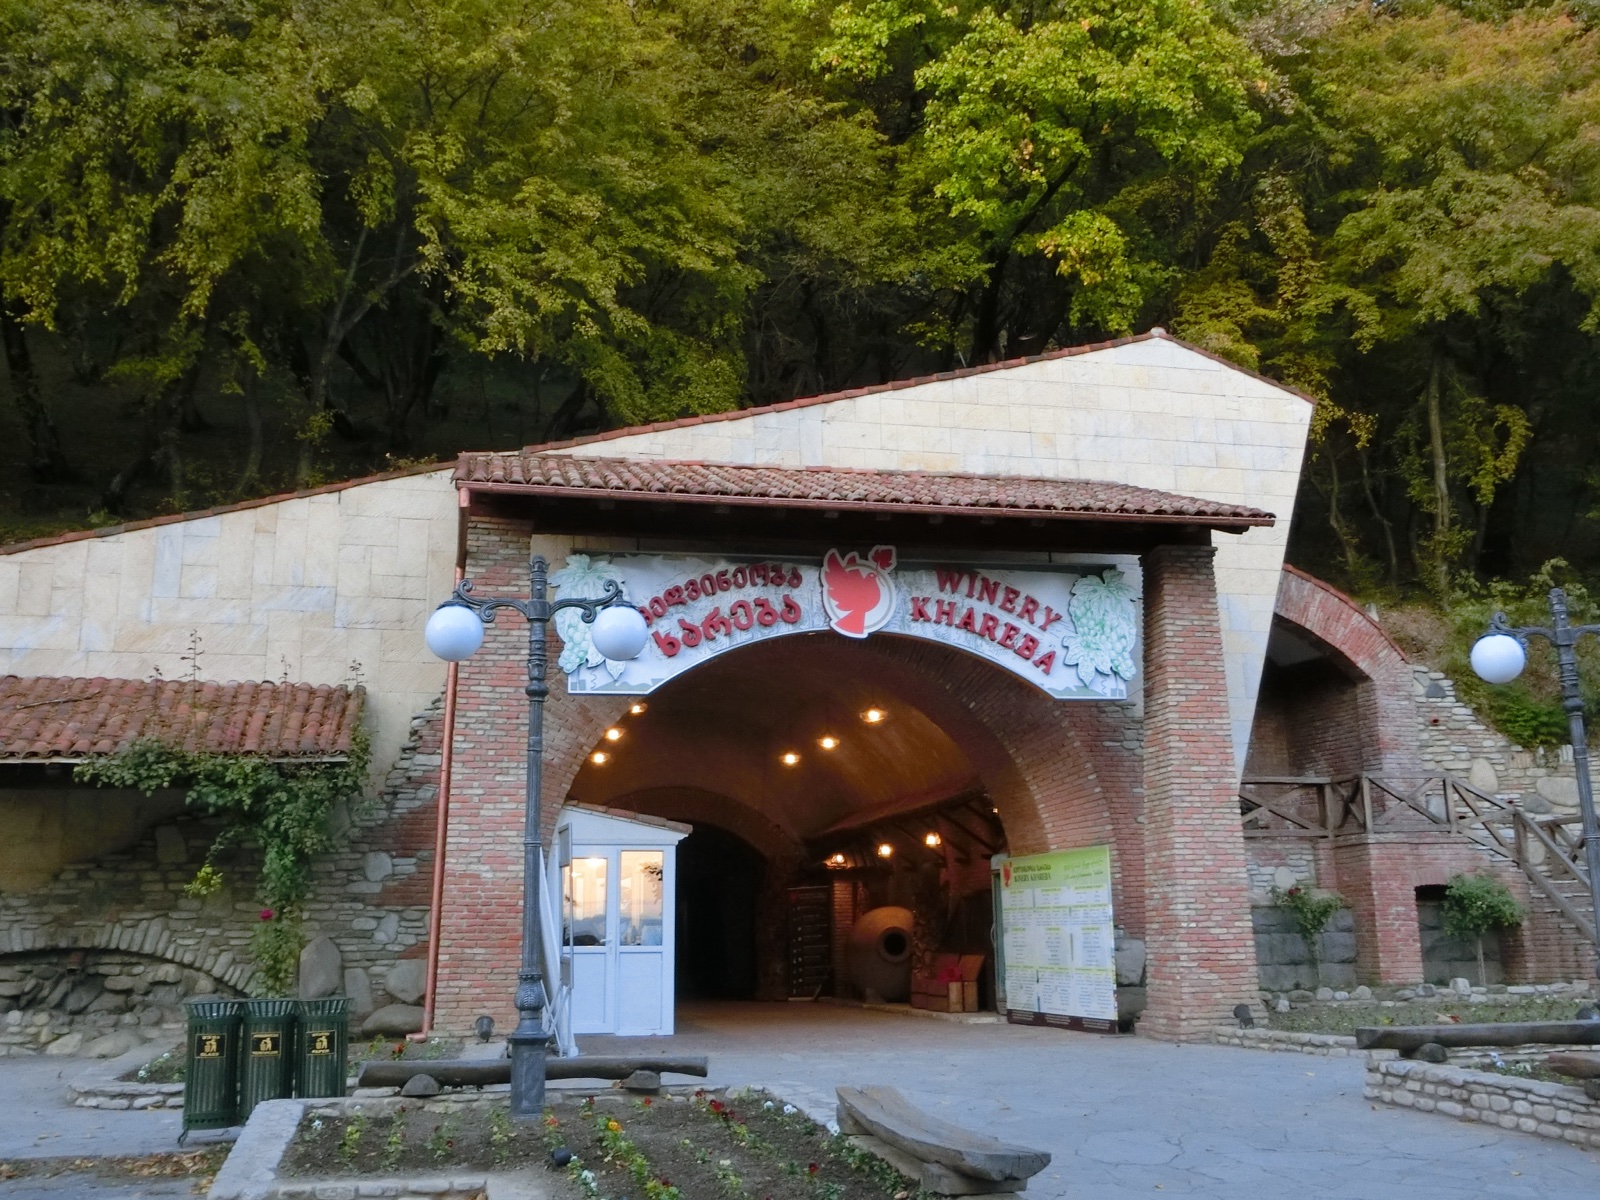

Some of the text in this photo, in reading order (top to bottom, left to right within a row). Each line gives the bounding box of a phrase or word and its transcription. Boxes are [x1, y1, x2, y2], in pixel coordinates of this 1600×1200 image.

[651, 594, 803, 657] ხარება
[936, 567, 1063, 632] WINERY
[910, 596, 1058, 675] KHAREBA
